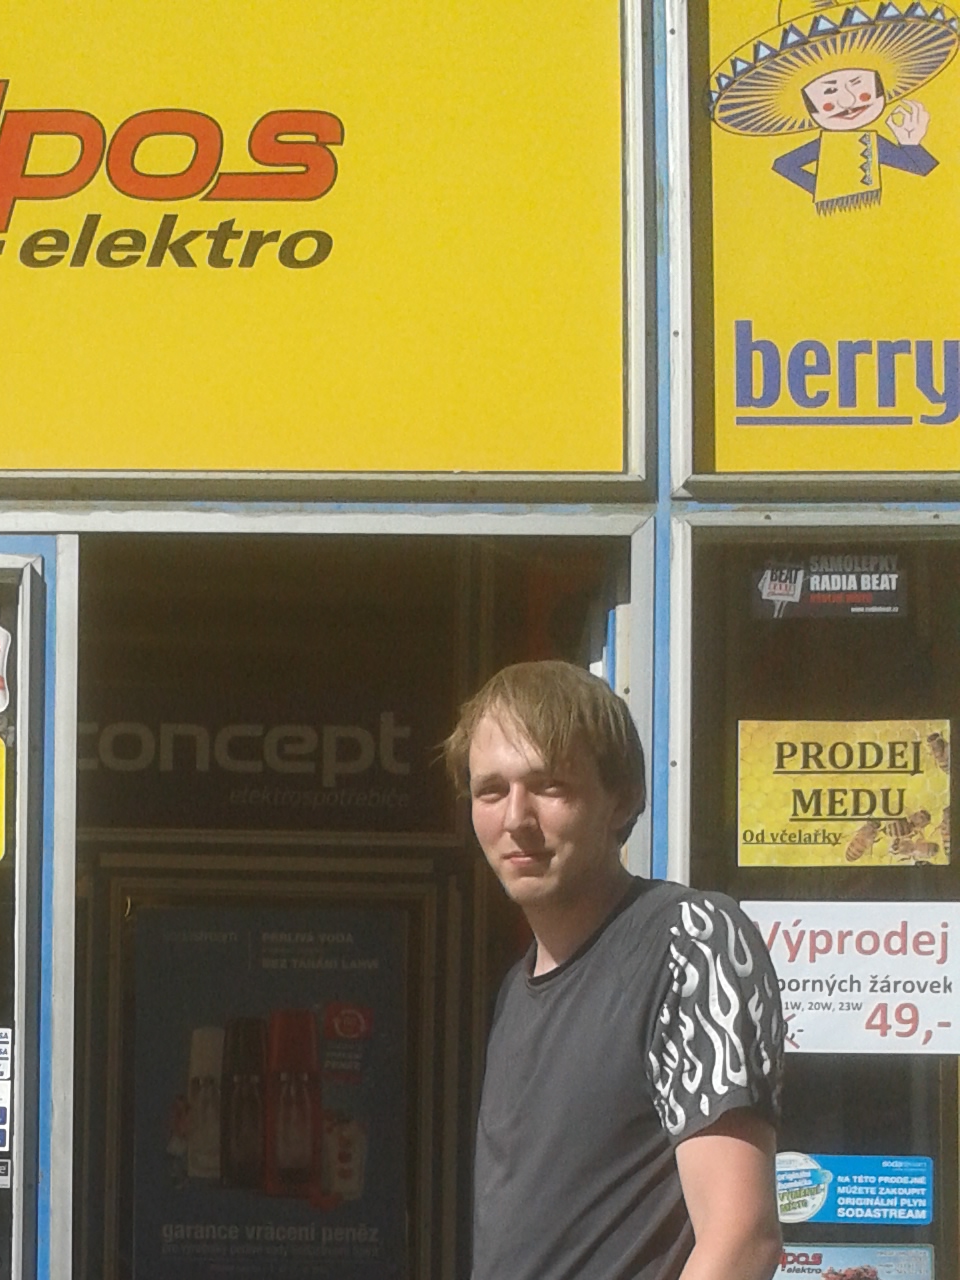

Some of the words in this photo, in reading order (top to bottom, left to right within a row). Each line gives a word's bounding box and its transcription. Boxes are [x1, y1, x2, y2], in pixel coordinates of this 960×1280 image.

[809, 554, 898, 572] SAMOLEPKY
[809, 574, 857, 591] RADIA
[860, 574, 899, 591] BEAT
[773, 740, 924, 777] PRODEJ
[789, 787, 907, 819] MEDU
[742, 828, 765, 845] Od
[769, 828, 843, 850] včelařky
[869, 974, 954, 994] žárovek
[784, 1001, 805, 1012] 1W,
[807, 1001, 836, 1012] 20W,
[838, 1001, 863, 1011] 23W
[864, 1002, 952, 1046] 49,-
[837, 1175, 851, 1183] NA
[852, 1174, 876, 1184] TÉTO
[837, 1185, 877, 1195] MŮŽETE
[878, 1186, 927, 1196] ZAKOUPIT
[900, 1198, 927, 1208] PLYN
[837, 1208, 928, 1220] SODASTREAM
[161, 1222, 240, 1243] garance
[244, 1221, 316, 1241] vrácení
[320, 1221, 380, 1243] peněz
